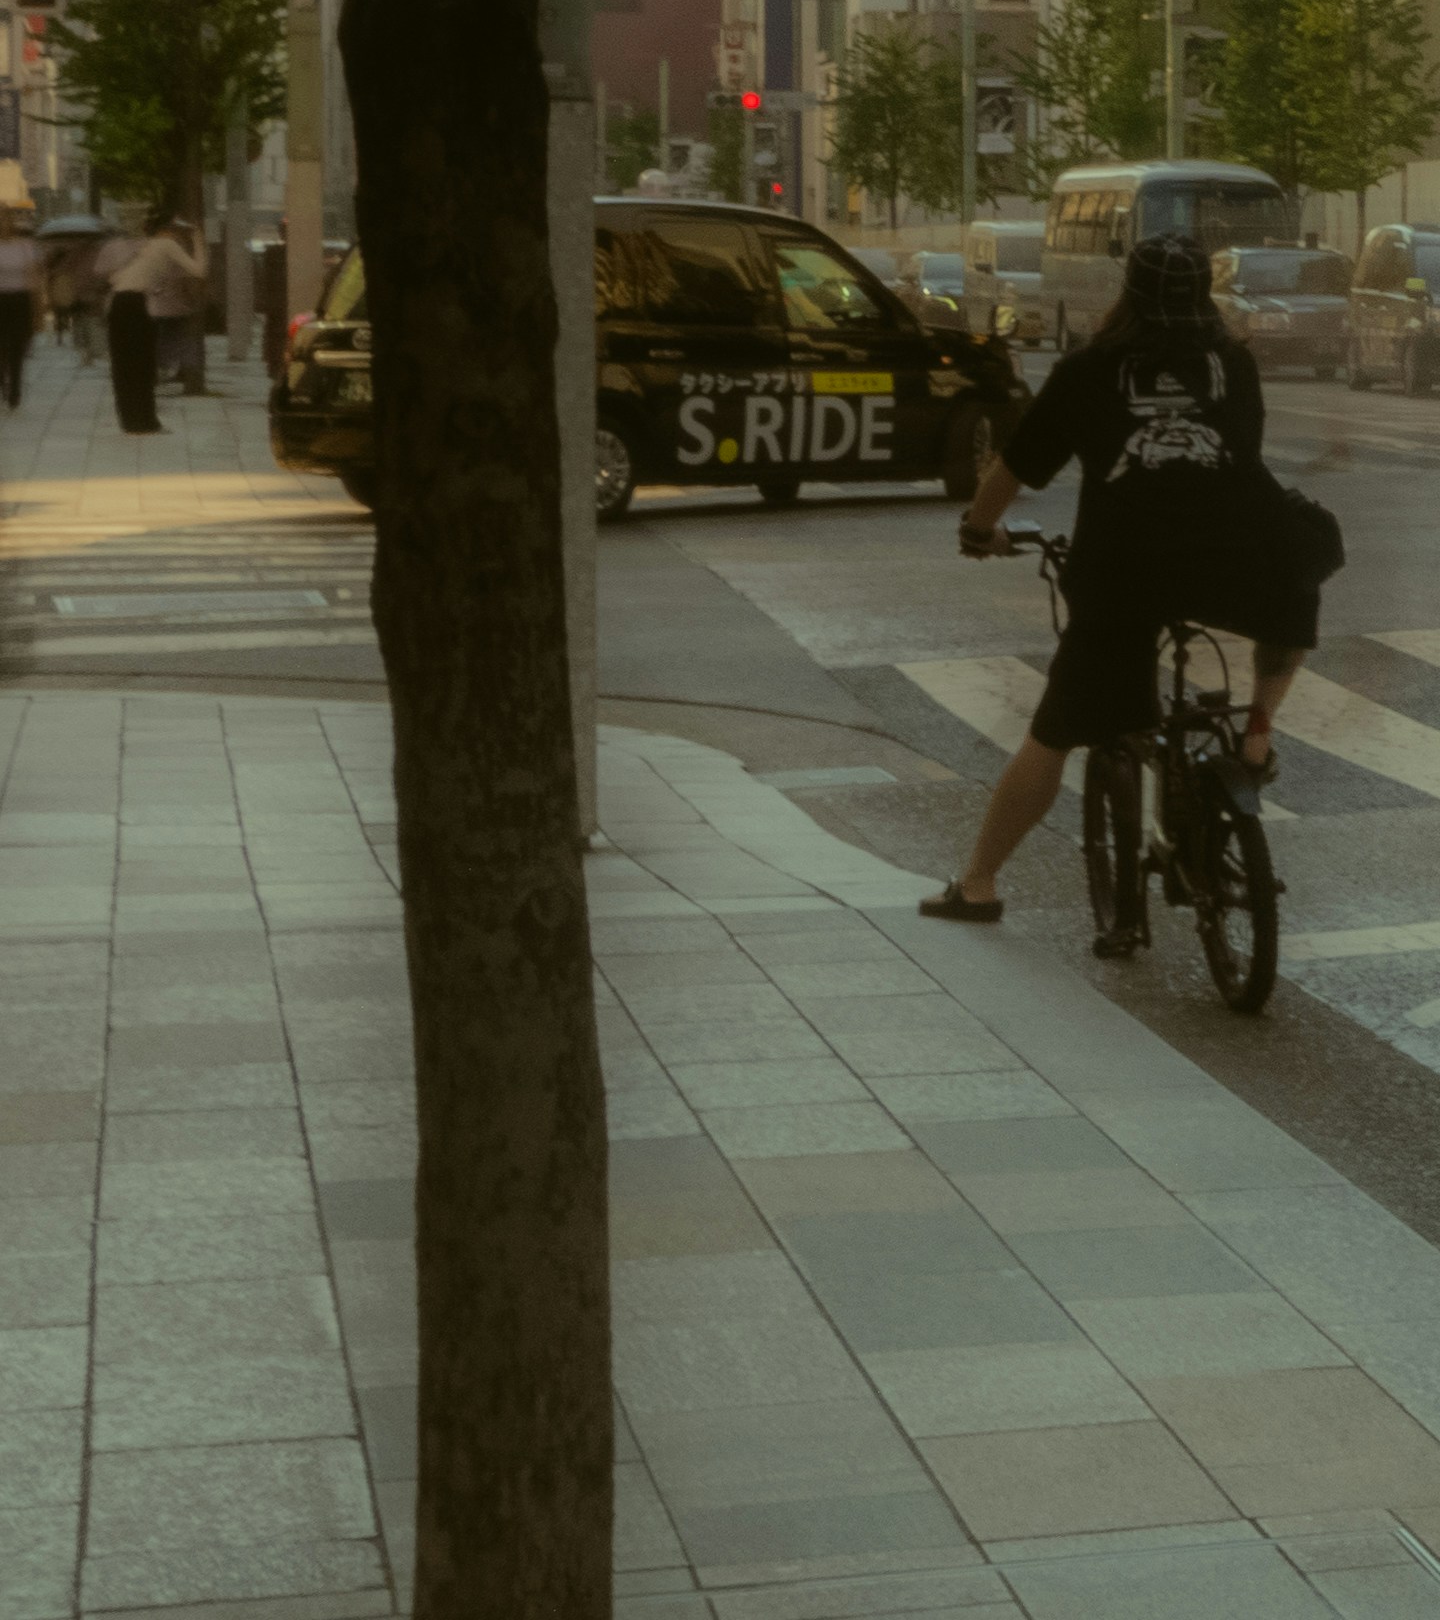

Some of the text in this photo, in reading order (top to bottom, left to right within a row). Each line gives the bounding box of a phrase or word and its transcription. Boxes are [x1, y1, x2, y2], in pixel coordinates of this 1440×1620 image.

[678, 371, 806, 394] タクシーアプリ
[677, 394, 896, 466] S.RIDE
